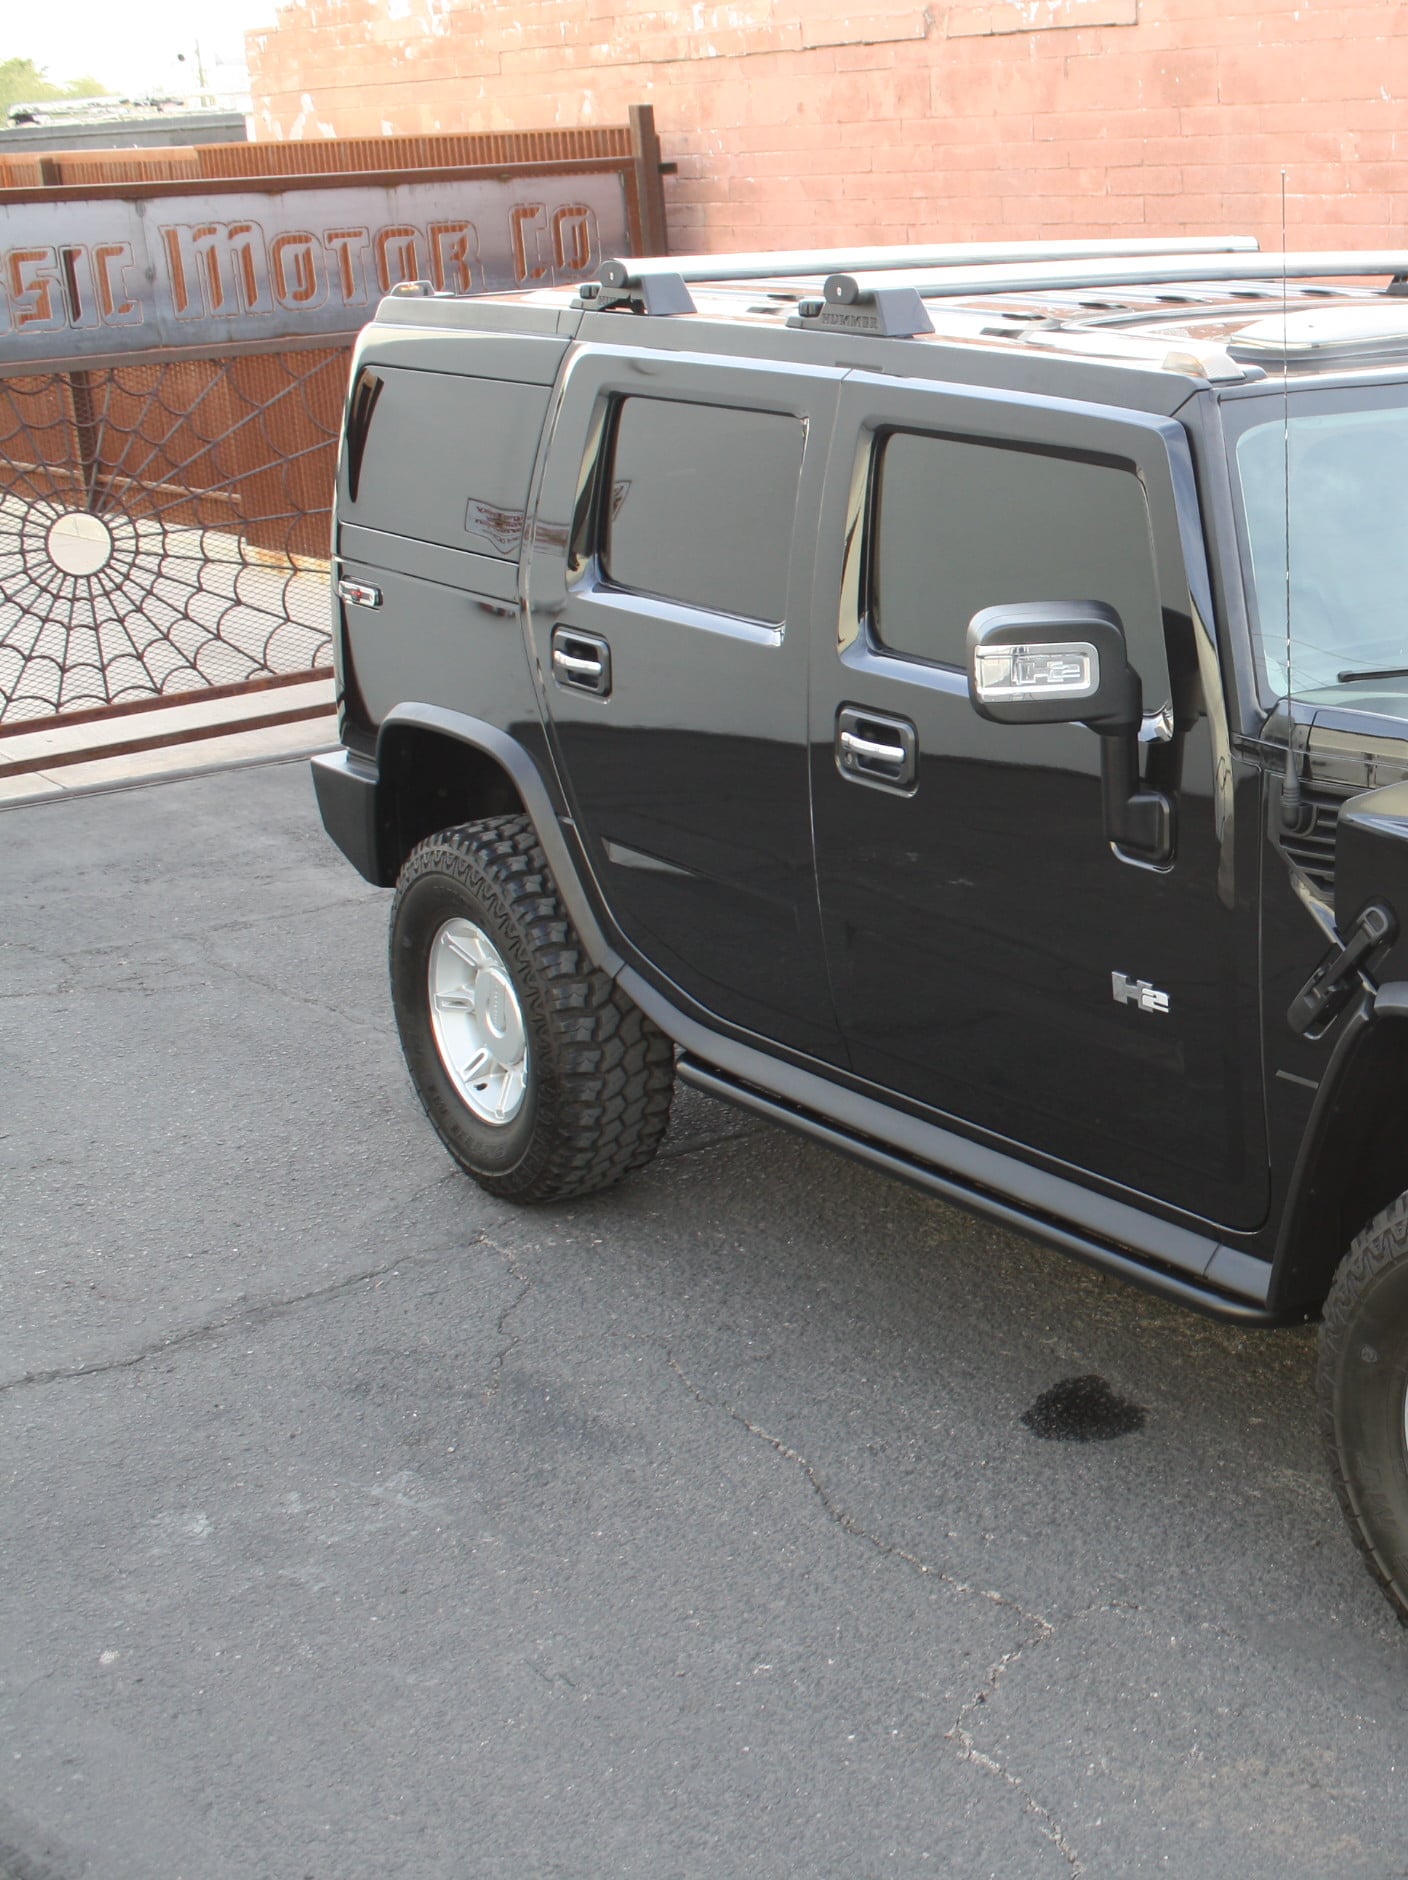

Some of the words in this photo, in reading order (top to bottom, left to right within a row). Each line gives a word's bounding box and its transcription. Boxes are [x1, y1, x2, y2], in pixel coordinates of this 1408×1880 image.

[0, 240, 144, 335] SIC
[158, 218, 488, 321] MOTOR
[508, 202, 602, 290] CO
[821, 311, 880, 330] HUMMER
[1111, 970, 1169, 1013] H2
